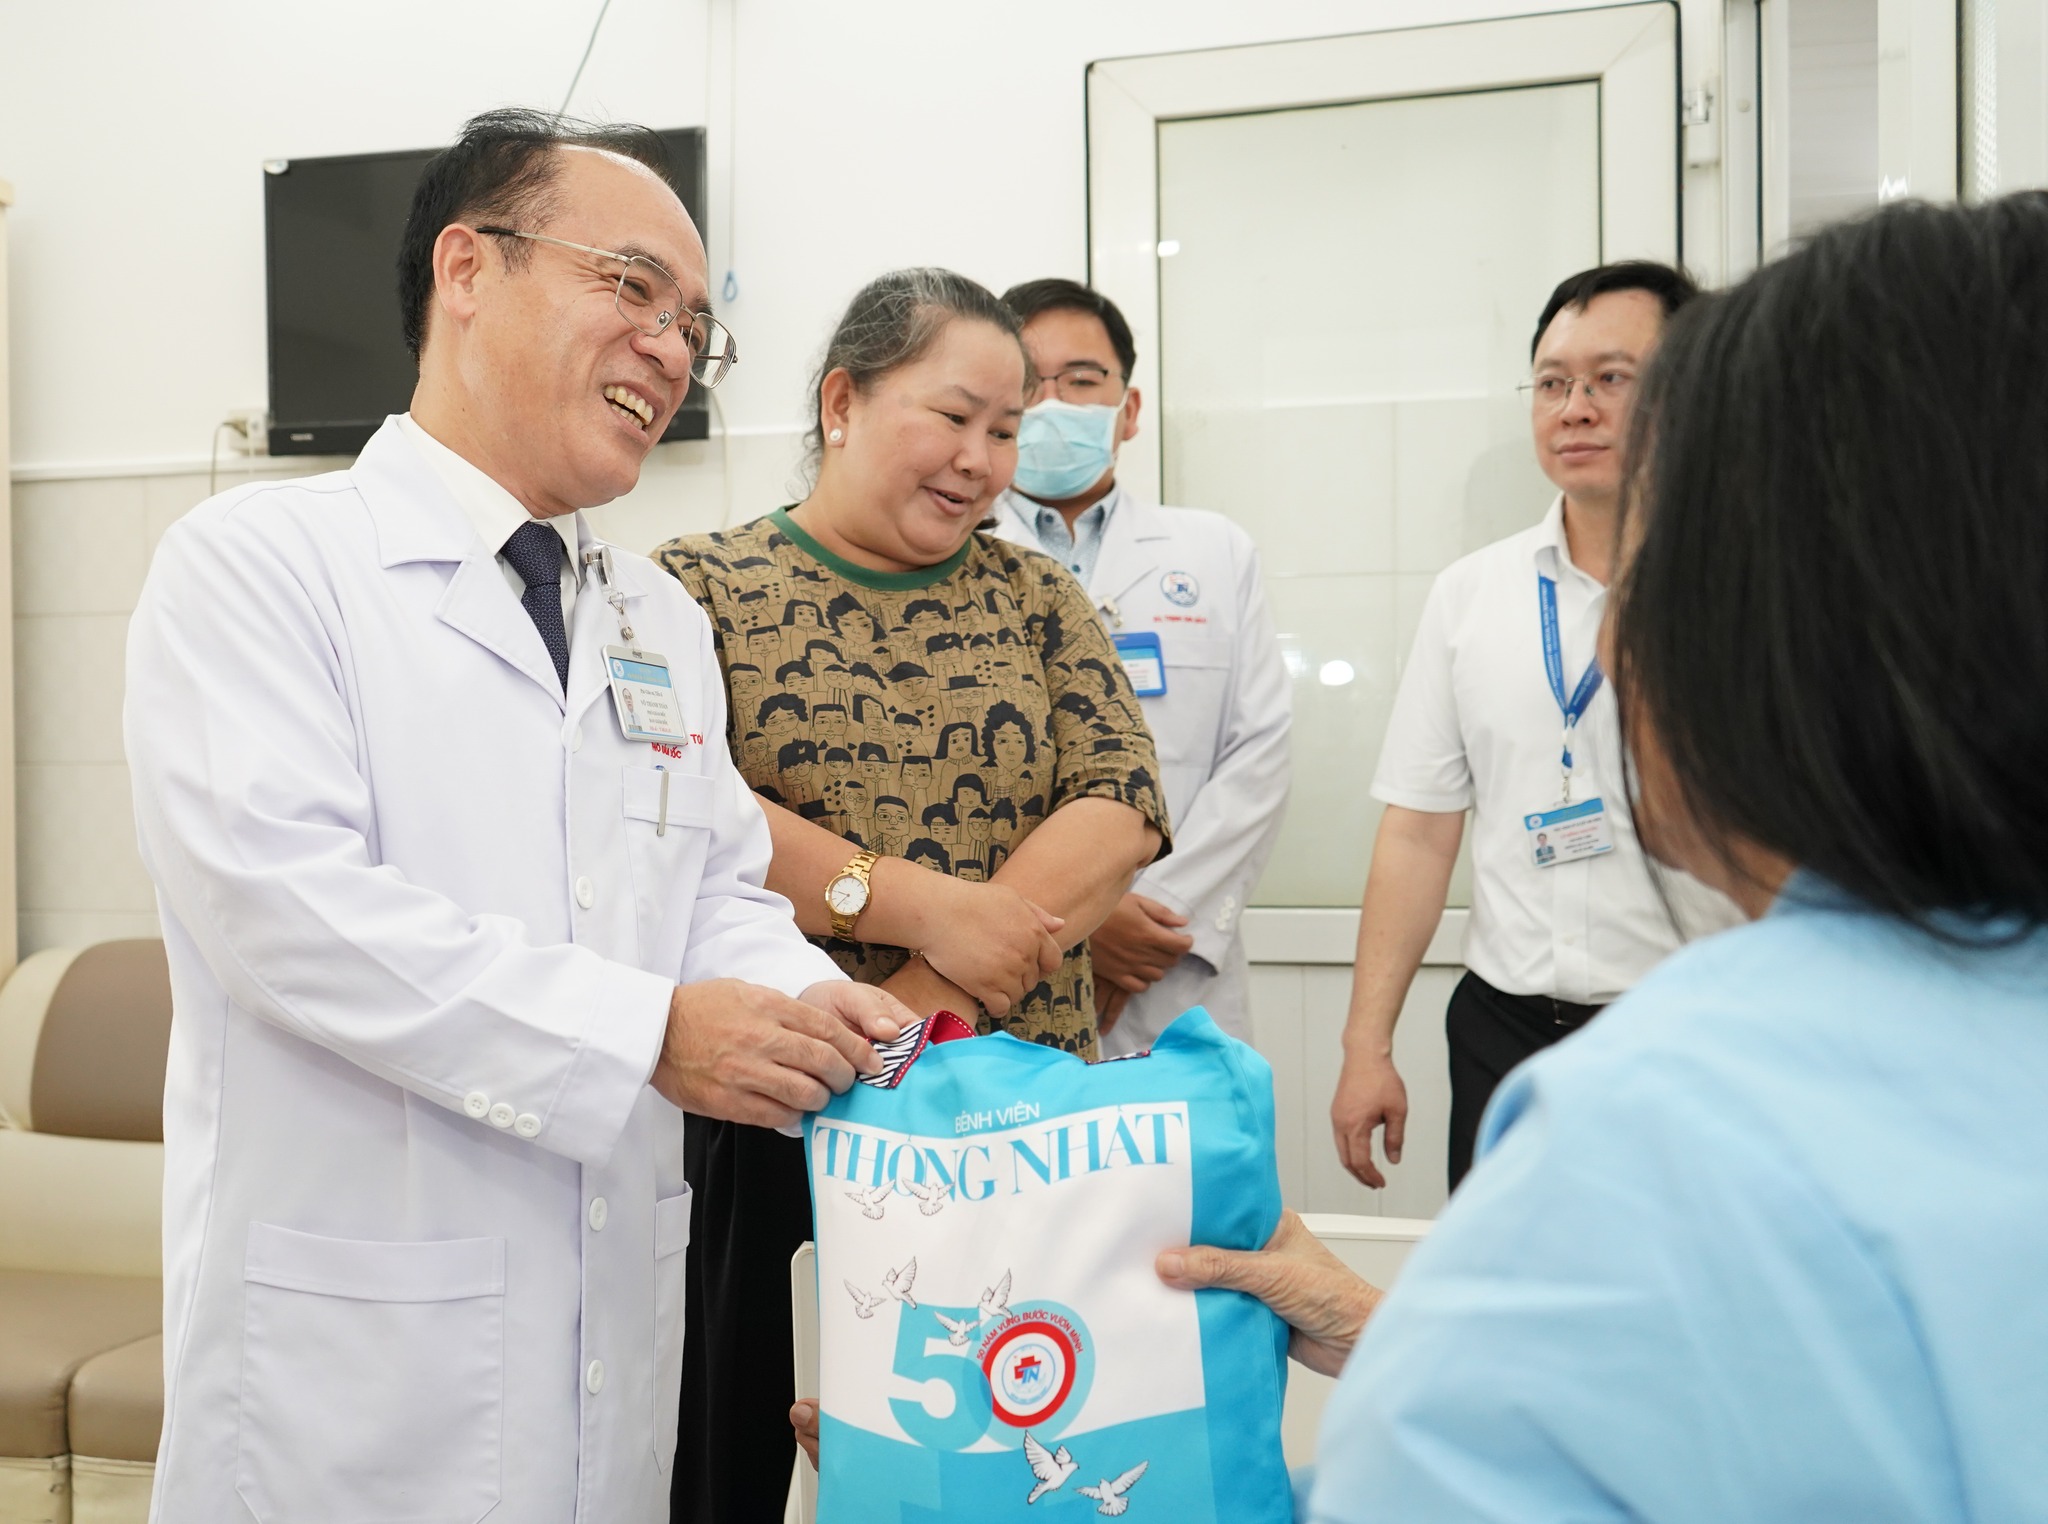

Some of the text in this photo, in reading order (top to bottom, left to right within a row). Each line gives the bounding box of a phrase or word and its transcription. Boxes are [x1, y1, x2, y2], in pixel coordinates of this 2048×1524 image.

[955, 1099, 1040, 1137] BỆNH VIỆN
[888, 1299, 1096, 1453] 50
